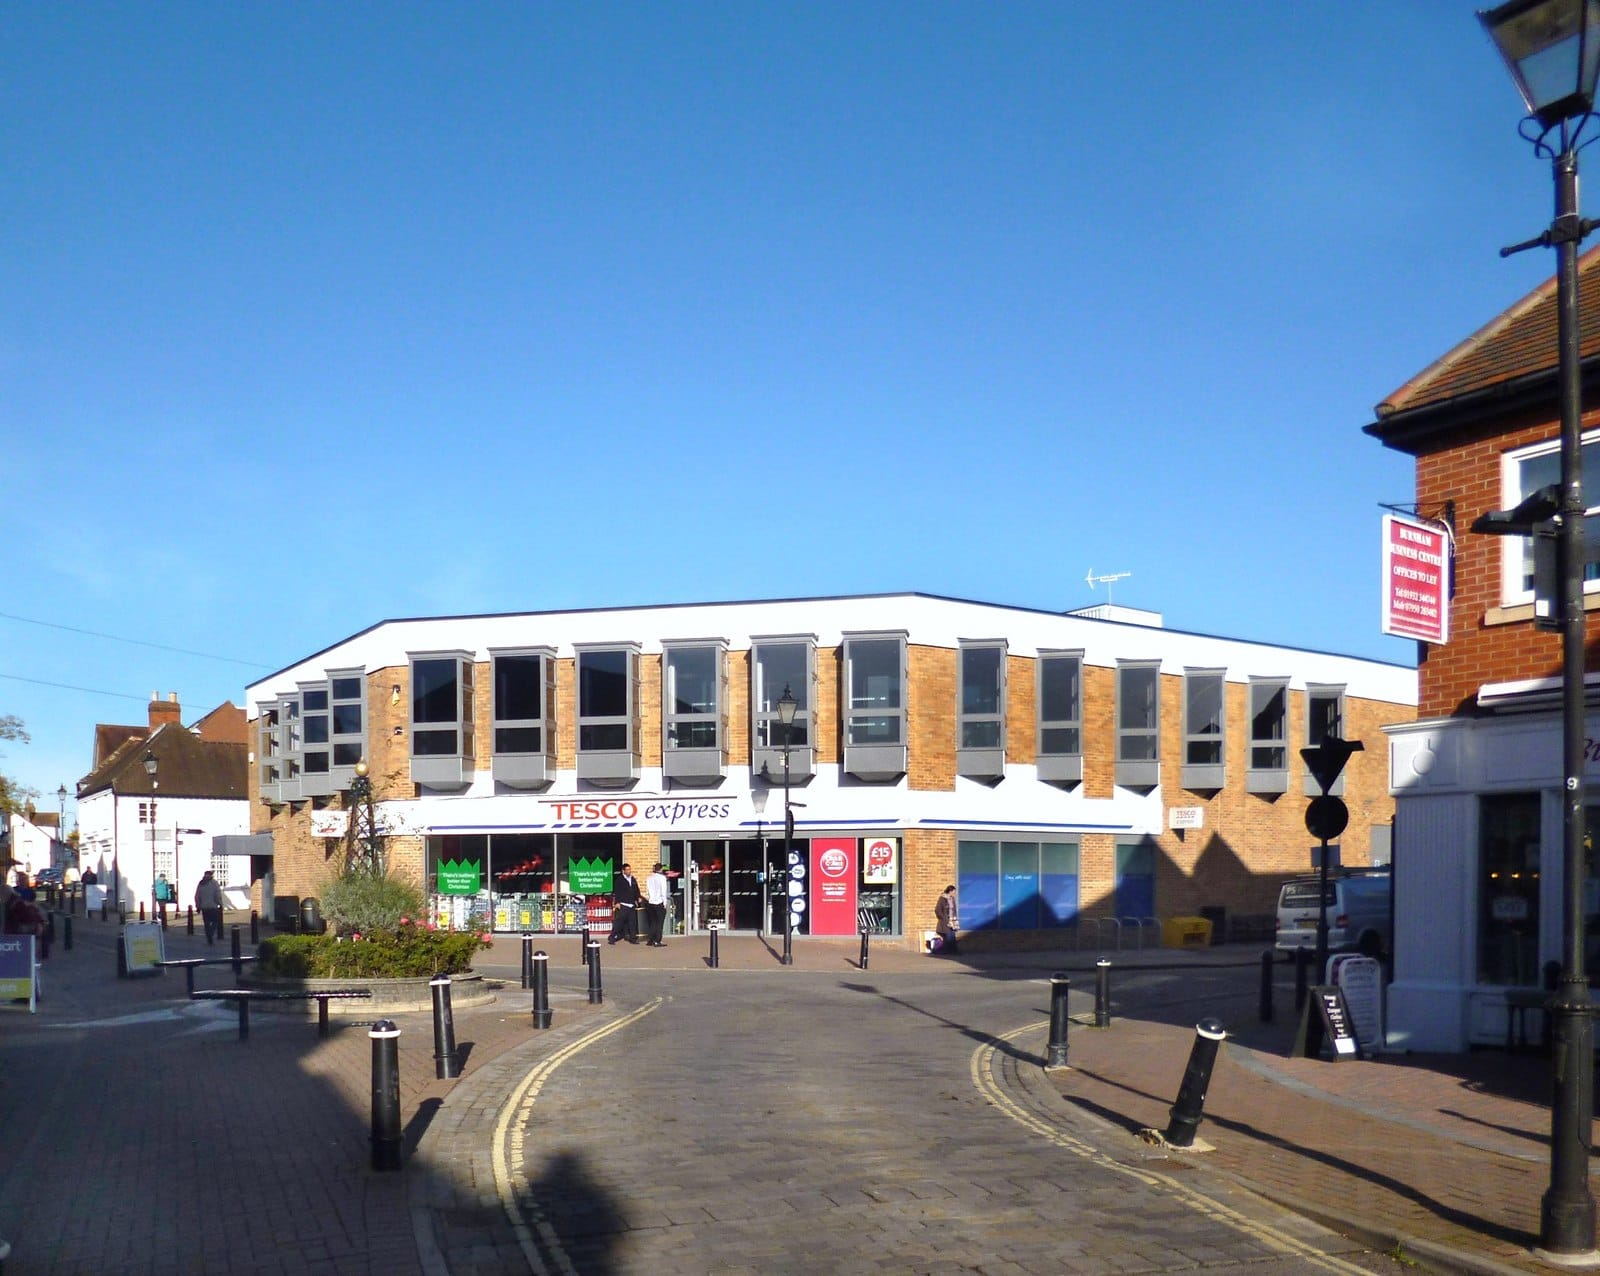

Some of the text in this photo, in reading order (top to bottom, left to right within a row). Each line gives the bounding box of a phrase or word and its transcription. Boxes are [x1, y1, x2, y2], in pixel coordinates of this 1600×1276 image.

[1400, 528, 1432, 546] BURNHAM
[1418, 550, 1441, 567] CENTRE
[1394, 565, 1438, 585] OFFICES TO LET
[1567, 777, 1578, 790] 9
[550, 802, 730, 824] TESCO express
[872, 847, 889, 858] £15
